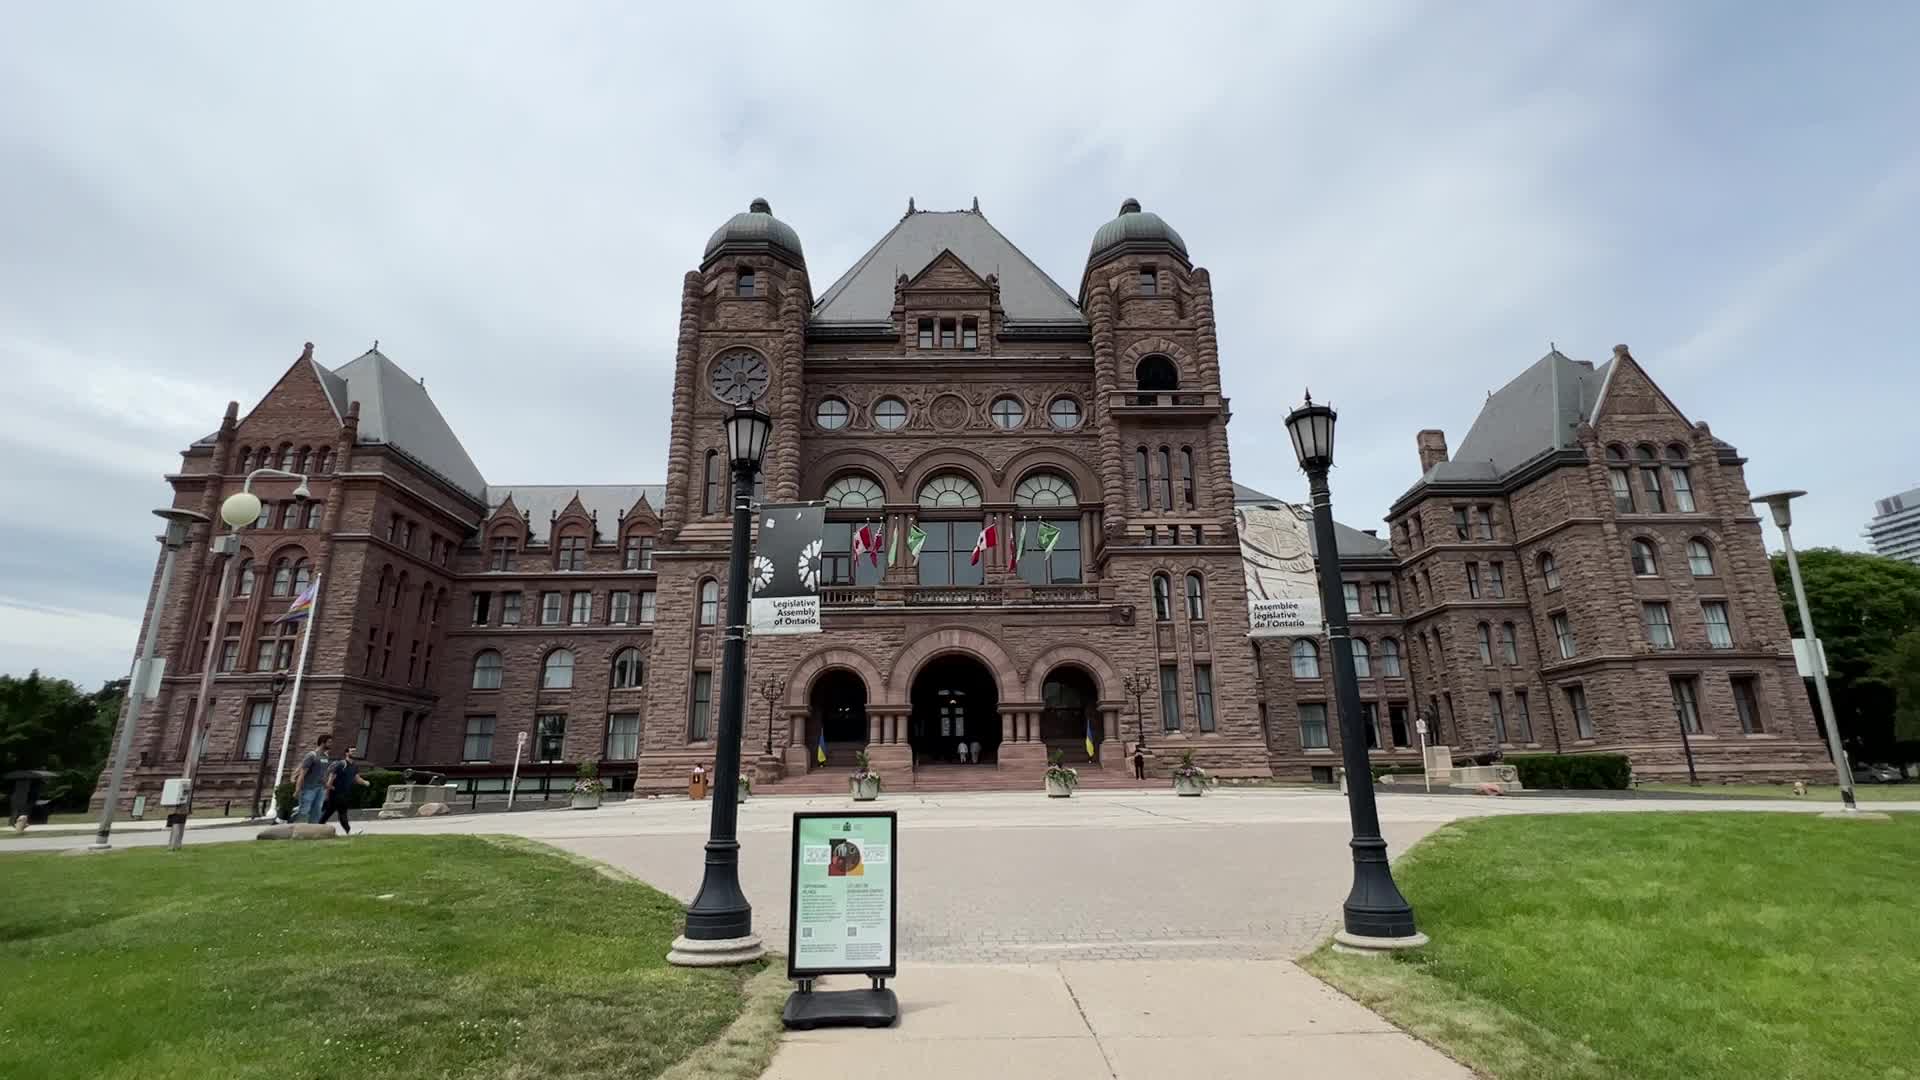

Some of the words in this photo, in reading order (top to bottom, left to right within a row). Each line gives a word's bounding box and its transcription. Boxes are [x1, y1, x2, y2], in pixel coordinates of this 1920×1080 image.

[773, 600, 816, 609] Legislative
[1254, 602, 1298, 610] Assemblée
[777, 608, 816, 617] Assembly
[1254, 610, 1297, 620] législative
[785, 617, 816, 625] Ontario
[1254, 620, 1265, 628] de
[1267, 619, 1305, 628] l'Ontario
